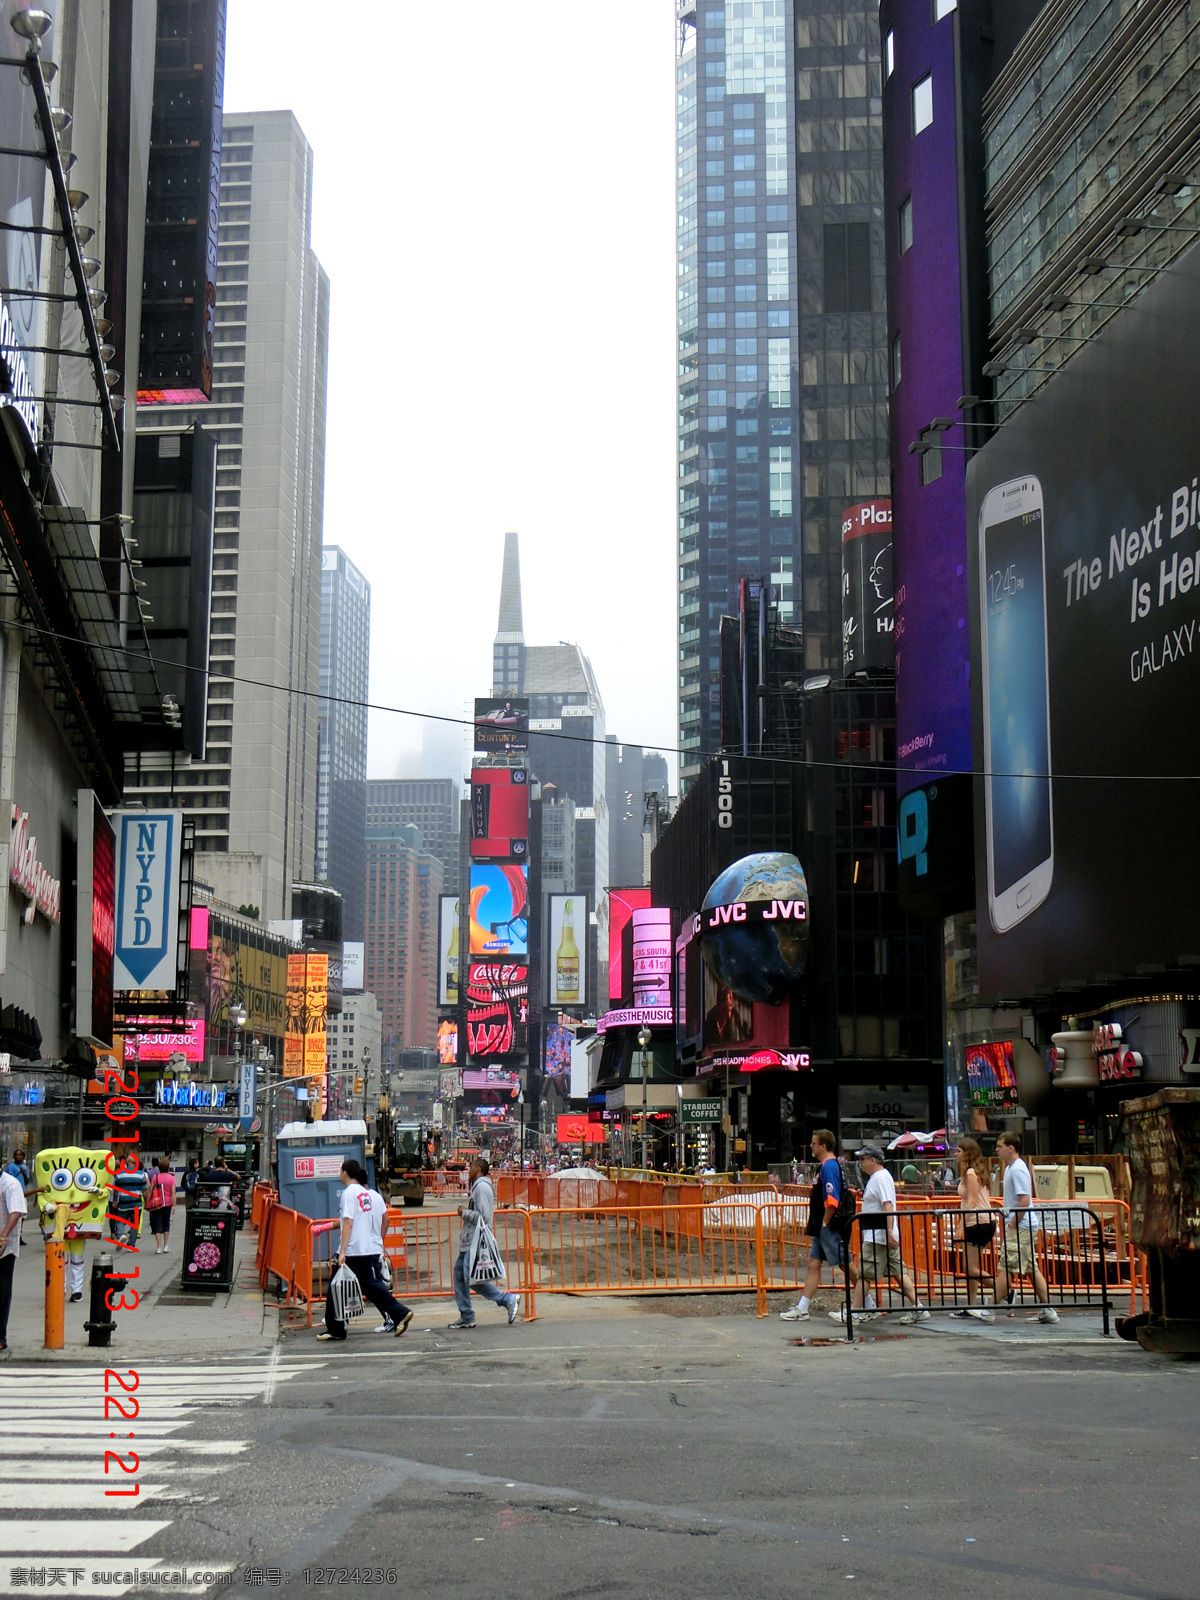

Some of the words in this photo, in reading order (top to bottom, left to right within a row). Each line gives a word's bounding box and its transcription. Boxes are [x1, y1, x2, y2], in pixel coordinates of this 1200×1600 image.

[1063, 557, 1101, 607] The
[1108, 505, 1164, 580] Next
[988, 564, 1016, 603] 12:45
[1130, 577, 1151, 624] Is
[1130, 619, 1196, 682] GALAXY
[901, 733, 934, 758] BlackBerry
[718, 760, 733, 829] 1500
[476, 787, 484, 836] XINHUA
[133, 822, 157, 946] NYPD
[709, 902, 747, 927] JVC
[762, 900, 806, 920] JVC
[646, 947, 667, 956] SOUTH
[723, 1056, 771, 1066] HEADPHONES
[781, 1053, 809, 1066] JVC
[156, 1079, 171, 1104] NEW
[171, 1080, 189, 1105] YORK
[189, 1081, 210, 1106] POLICE
[243, 1066, 252, 1116] NYPD
[690, 1110, 719, 1118] COFFEE
[865, 1103, 902, 1115] 1500
